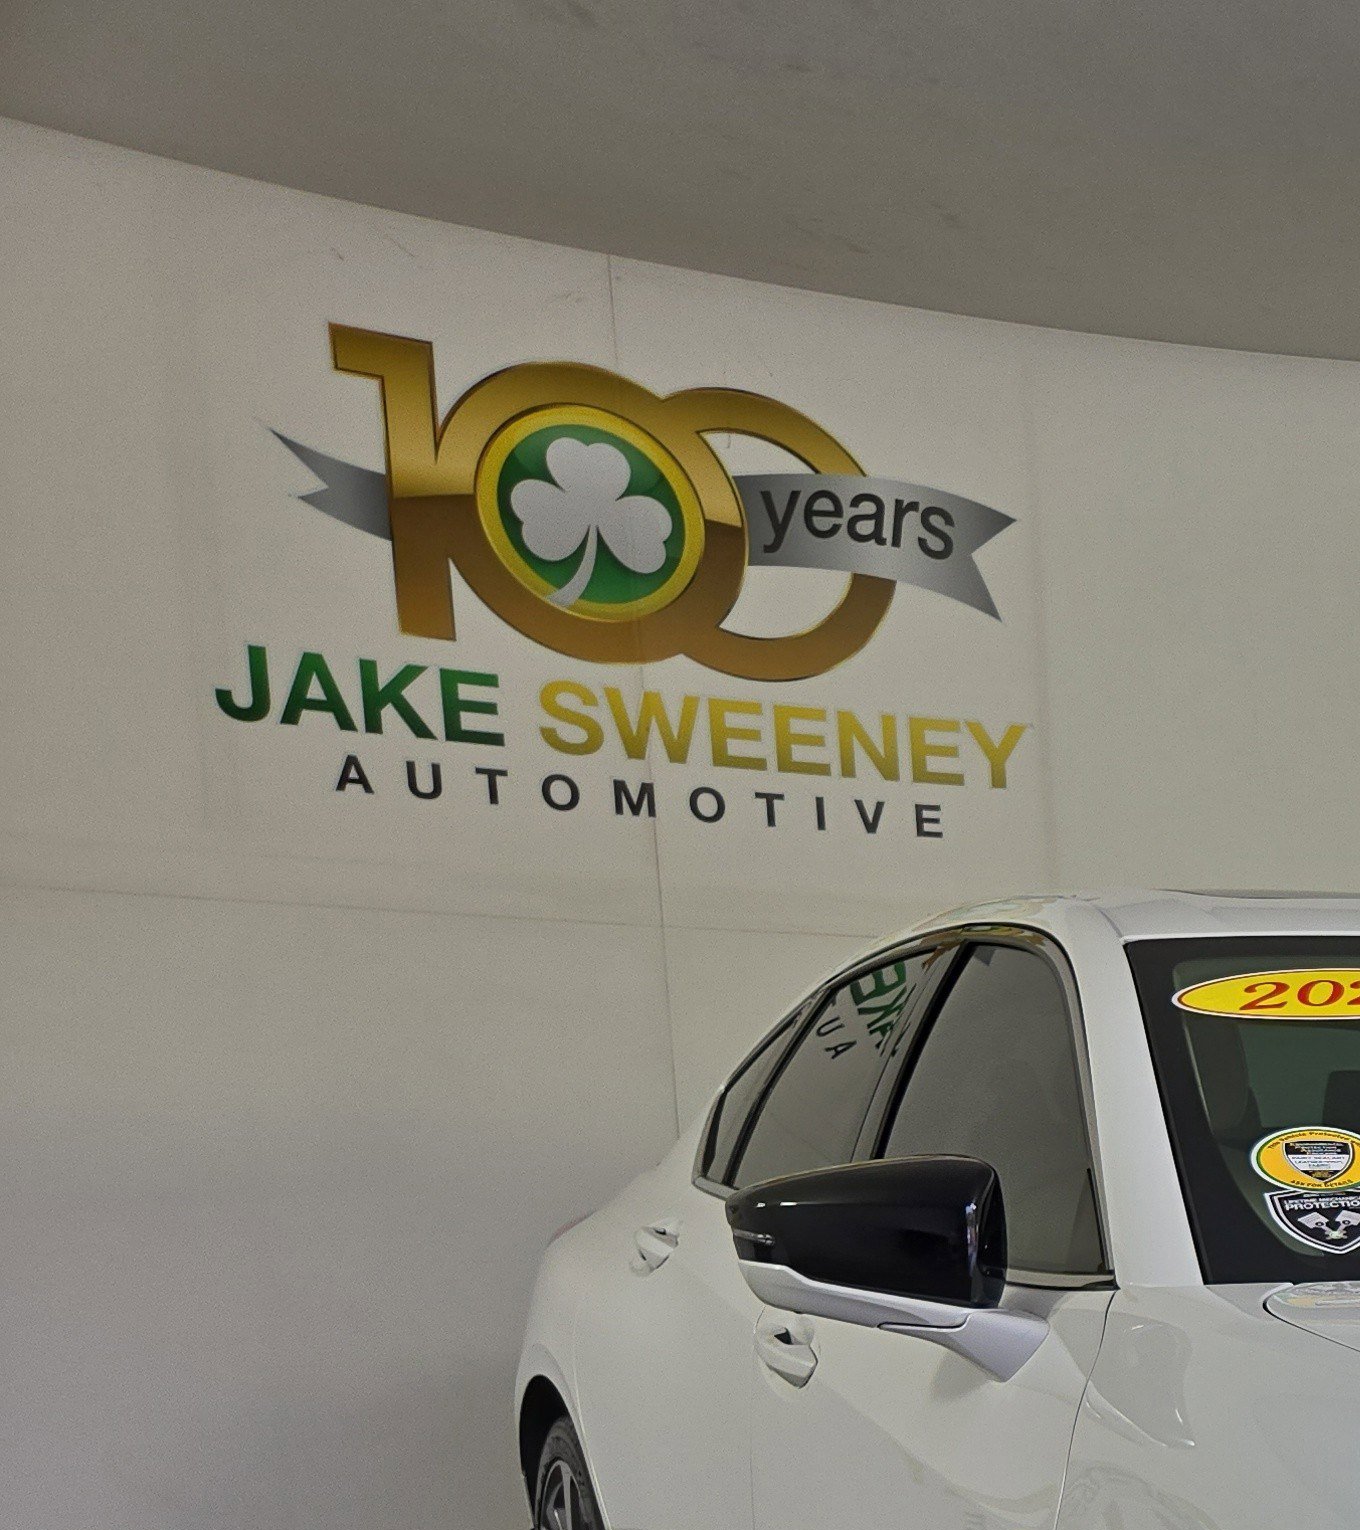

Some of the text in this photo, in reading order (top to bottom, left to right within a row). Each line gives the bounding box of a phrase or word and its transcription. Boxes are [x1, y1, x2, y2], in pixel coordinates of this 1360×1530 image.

[760, 485, 955, 560] years
[215, 643, 1028, 788] JAKE SWEENEY
[336, 754, 943, 838] AUTOMOTIVE
